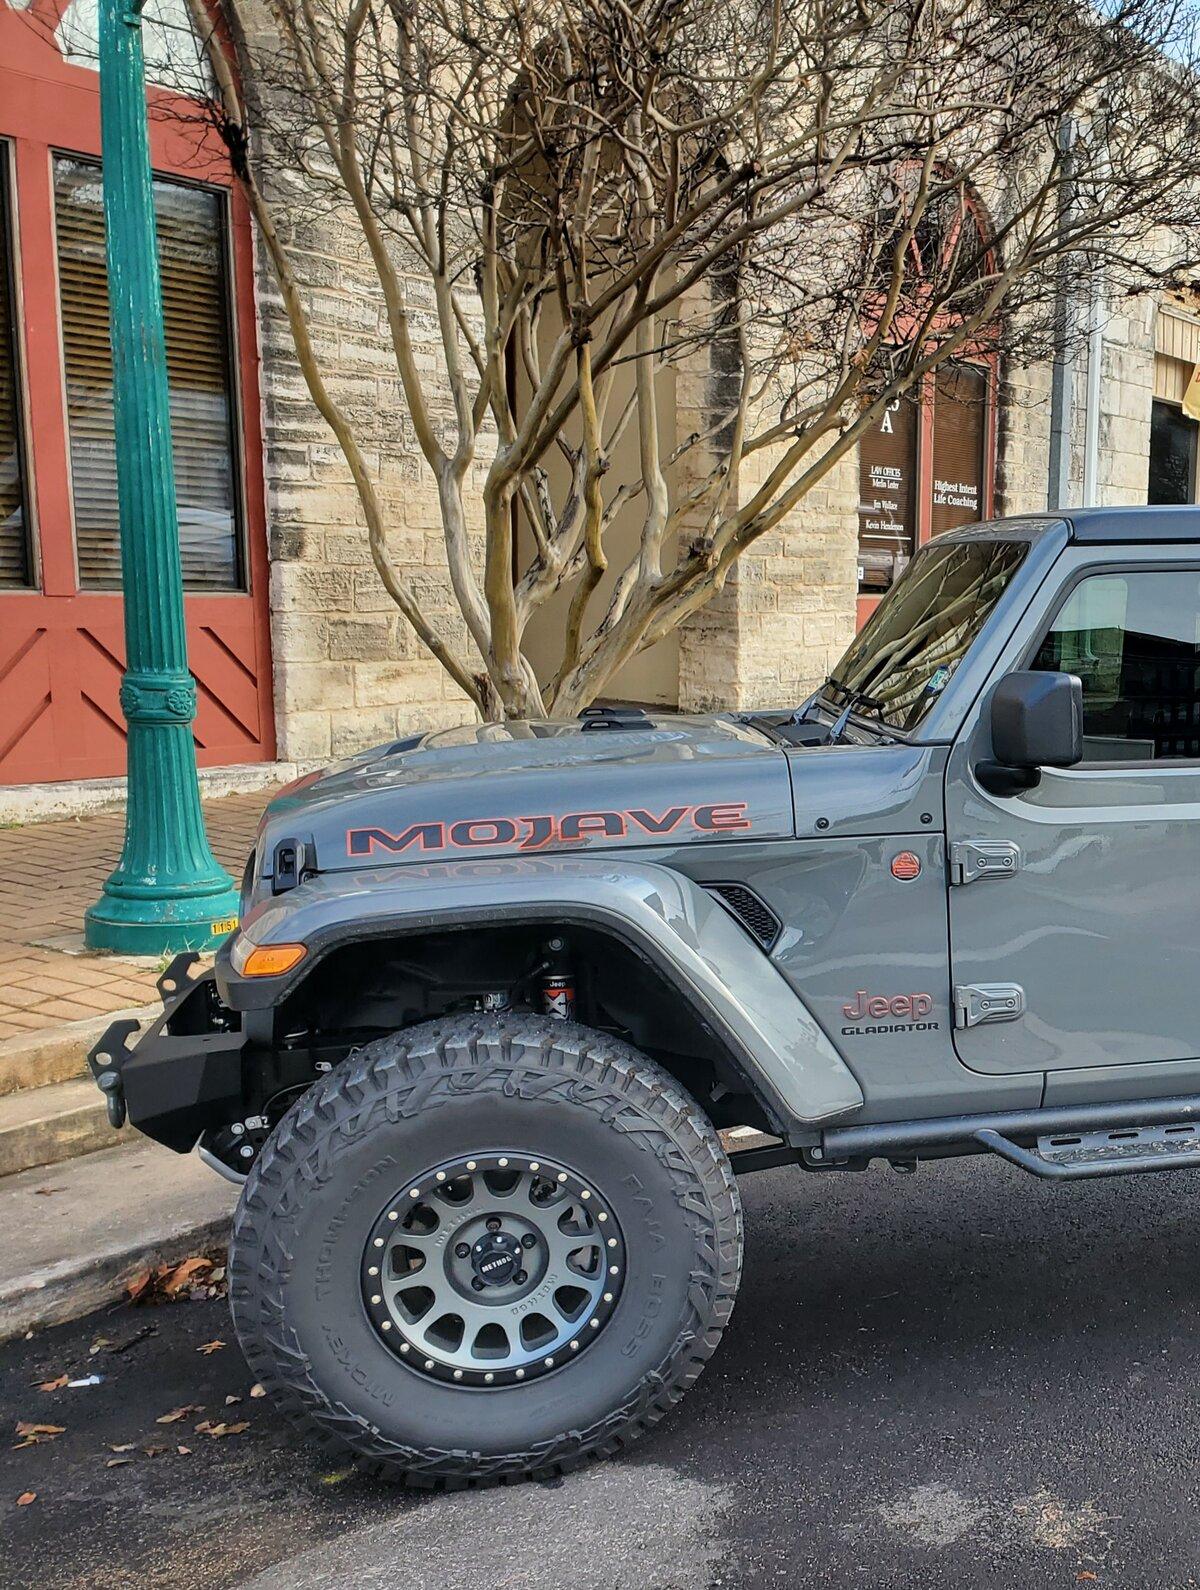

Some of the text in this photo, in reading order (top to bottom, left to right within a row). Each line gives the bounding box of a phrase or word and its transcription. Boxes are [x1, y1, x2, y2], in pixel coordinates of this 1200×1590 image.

[880, 410, 893, 434] A
[934, 480, 977, 495] Highest Intent
[933, 493, 977, 511] Life Coaching
[347, 802, 751, 857] MOJAVE
[843, 990, 932, 1021] Jeep
[841, 1022, 940, 1036] GLADIATOR
[481, 1255, 512, 1273] METHOD
